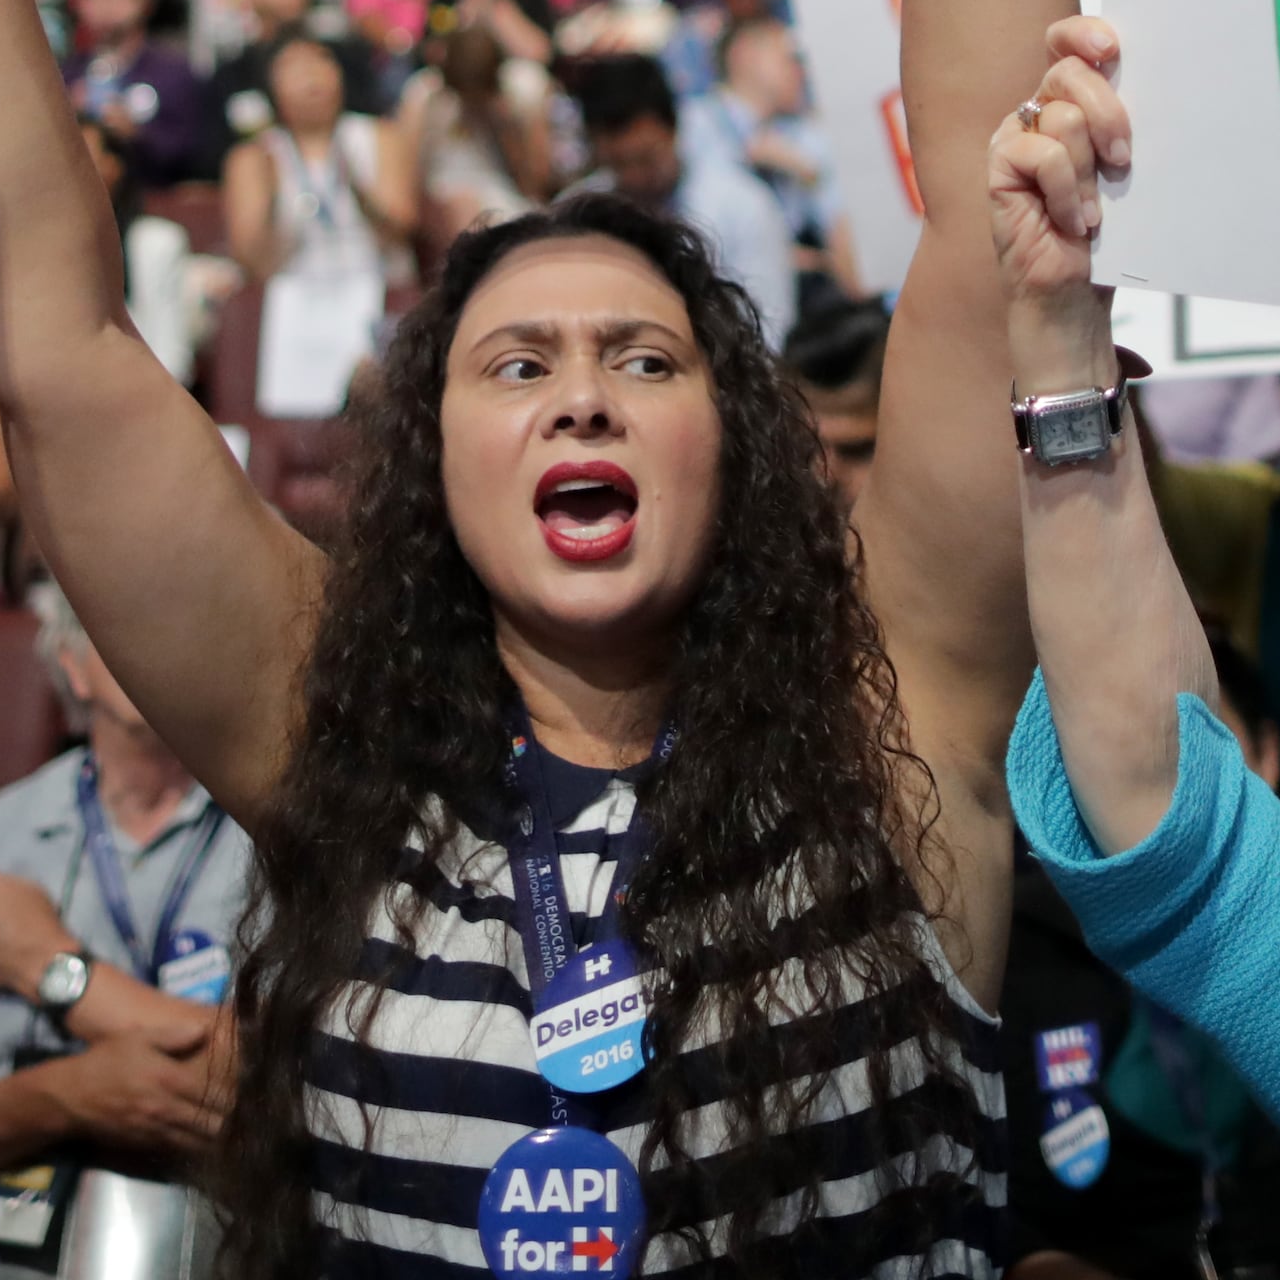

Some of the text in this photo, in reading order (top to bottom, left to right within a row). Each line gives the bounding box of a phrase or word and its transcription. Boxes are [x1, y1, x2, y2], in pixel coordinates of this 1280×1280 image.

[525, 858, 555, 982] NATIONAL CONVENTIO
[544, 895, 568, 969] DEMOCRA
[536, 990, 646, 1048] Delega
[580, 1039, 635, 1076] 2016
[499, 1168, 618, 1213] AAPI
[500, 1227, 566, 1272] for
